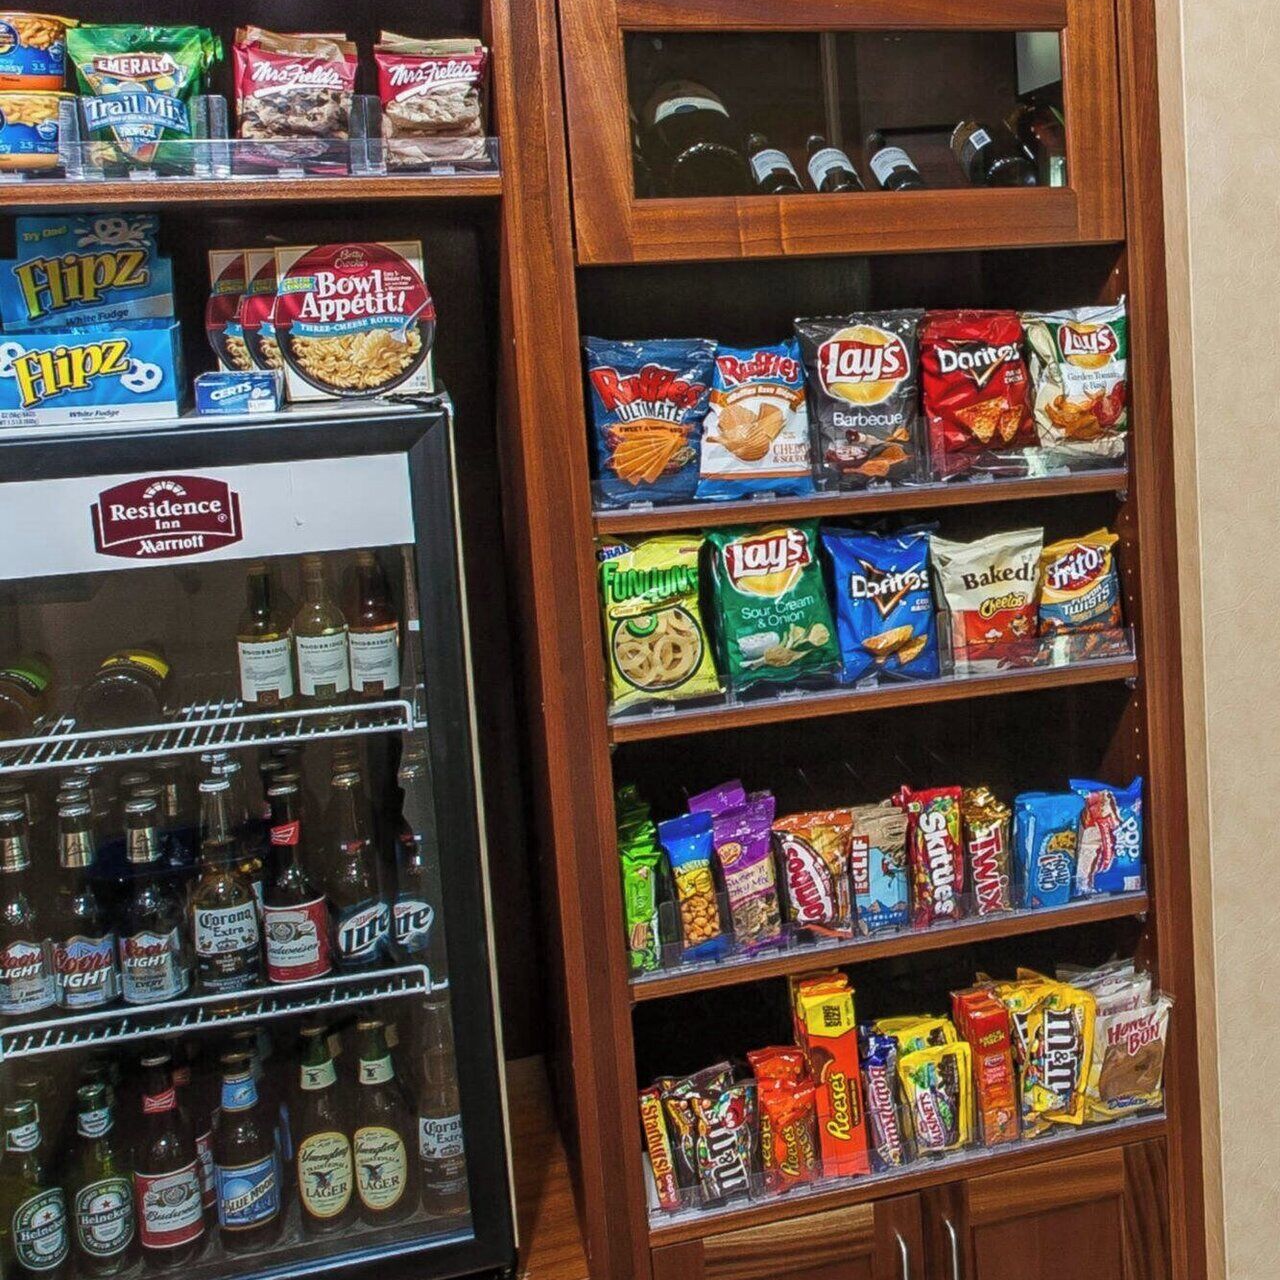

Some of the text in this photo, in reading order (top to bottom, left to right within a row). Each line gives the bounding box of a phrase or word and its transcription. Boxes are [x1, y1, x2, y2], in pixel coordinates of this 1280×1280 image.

[98, 58, 168, 76] EMERALD
[87, 96, 185, 121] Trail Mix
[14, 248, 148, 320] Flipz
[314, 270, 384, 298] Bowl
[98, 308, 129, 322] Fudge
[716, 352, 799, 389] Ruffles
[826, 344, 901, 384] Lay's
[936, 344, 1021, 372] Doritos
[14, 339, 132, 408] Flipz
[211, 381, 252, 401] CERTS
[589, 366, 706, 410] Ruffles
[616, 401, 684, 423] ULTIMATE
[833, 412, 903, 427] Barbecue
[110, 498, 222, 522] Residence
[154, 518, 181, 530] Inn
[136, 535, 204, 556] Marriott
[733, 528, 804, 577] Lay's
[961, 563, 1036, 591] Baked!
[1048, 546, 1107, 590] Fritos
[852, 570, 930, 599] Doritos
[741, 594, 815, 620] Sour Cream
[757, 609, 805, 629] & Onion
[979, 594, 1027, 619] Cheetos
[919, 811, 956, 915] Skittles
[200, 907, 254, 931] Corona
[213, 924, 244, 939] Extra
[1107, 1017, 1153, 1045] HONEY
[1128, 1023, 1161, 1056] BUN
[826, 1072, 852, 1141] Reese's
[305, 1182, 348, 1199] LAGER
[359, 1176, 401, 1191] LAGER
